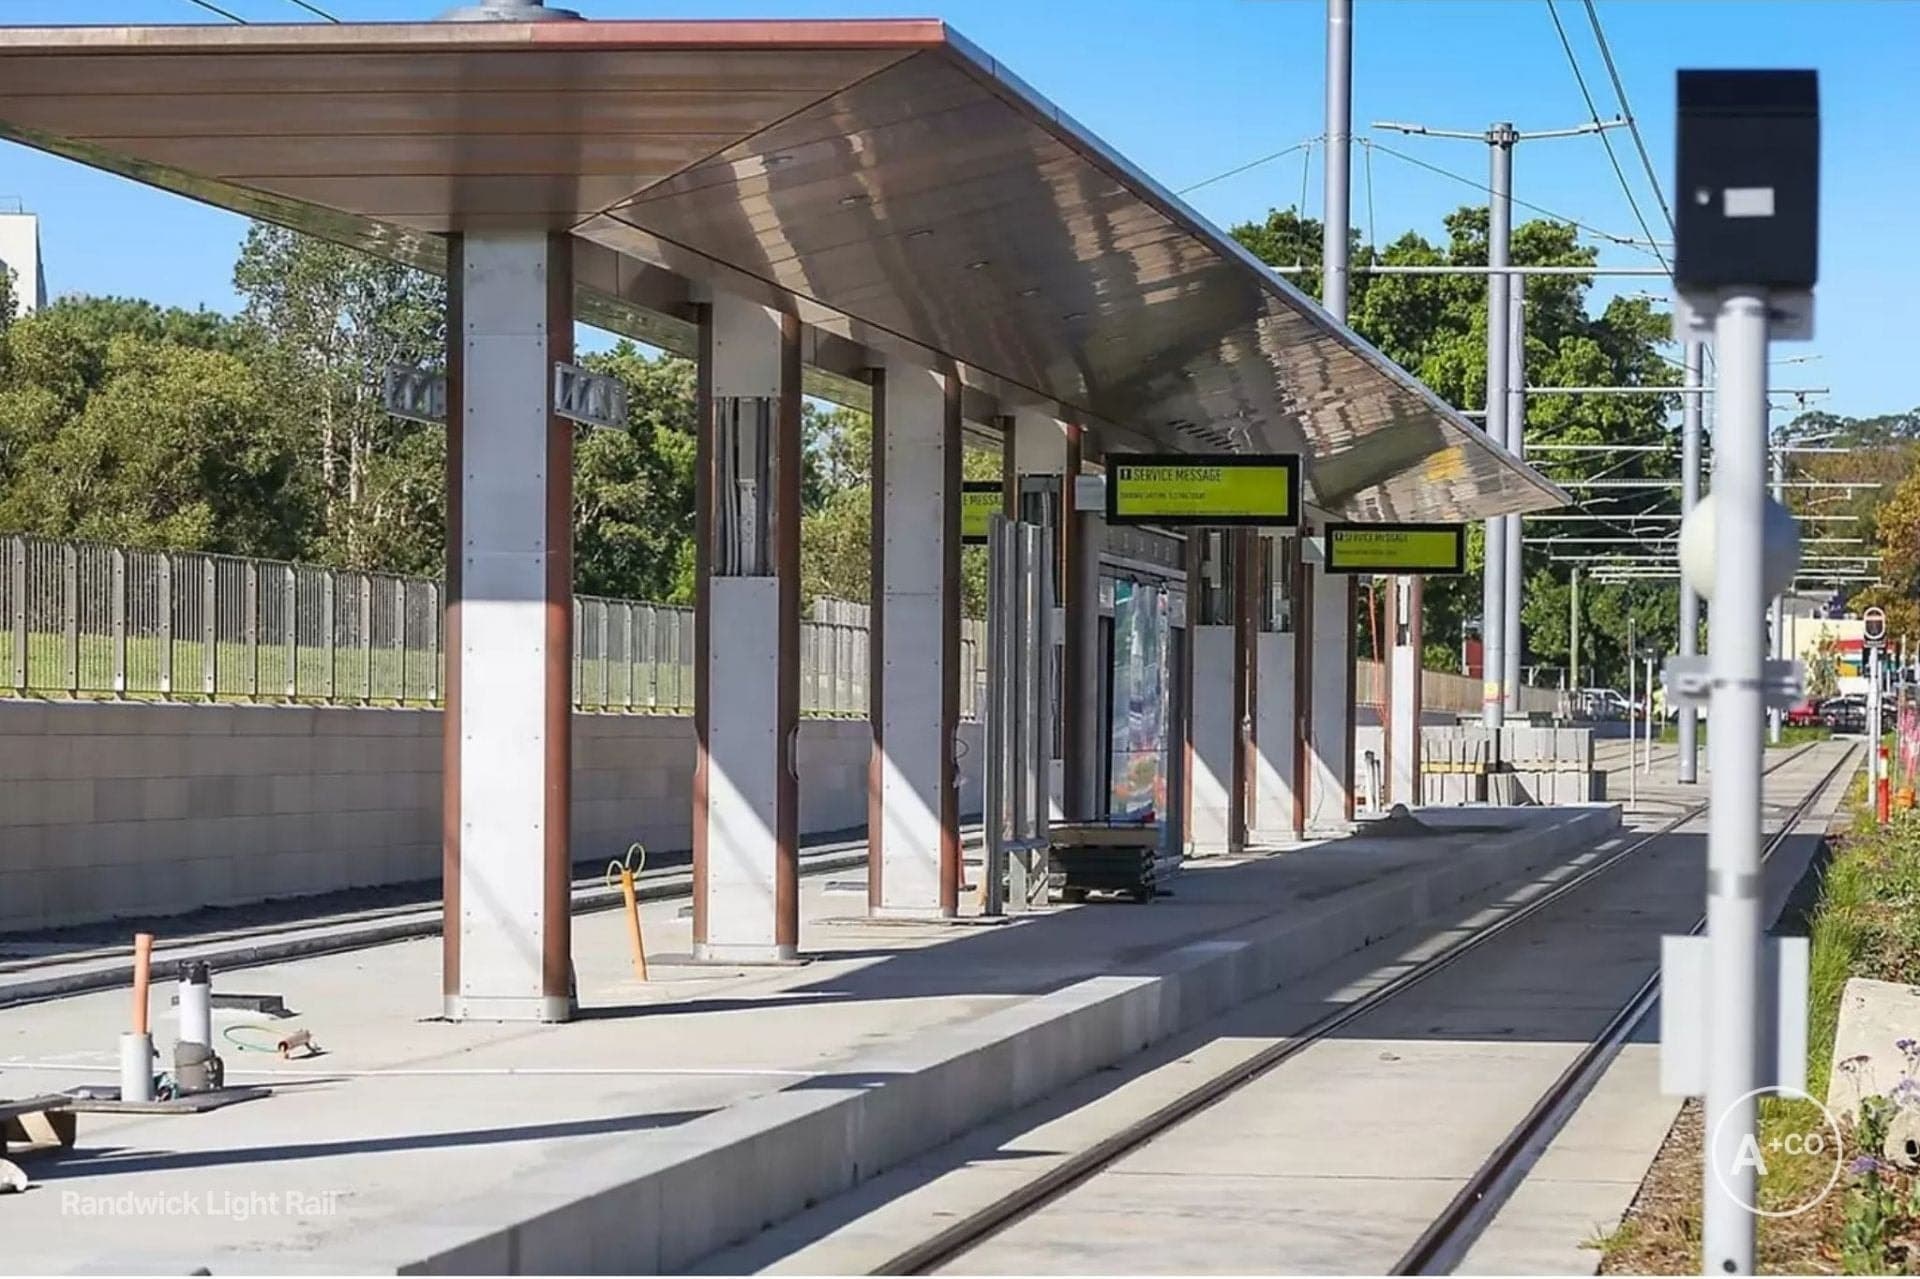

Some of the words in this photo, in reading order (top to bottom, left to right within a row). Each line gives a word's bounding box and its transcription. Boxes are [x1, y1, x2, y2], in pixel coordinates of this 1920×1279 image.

[1133, 468, 1173, 481] SERVICE
[1175, 468, 1221, 481] MESSAGE
[969, 494, 1001, 506] MESSA
